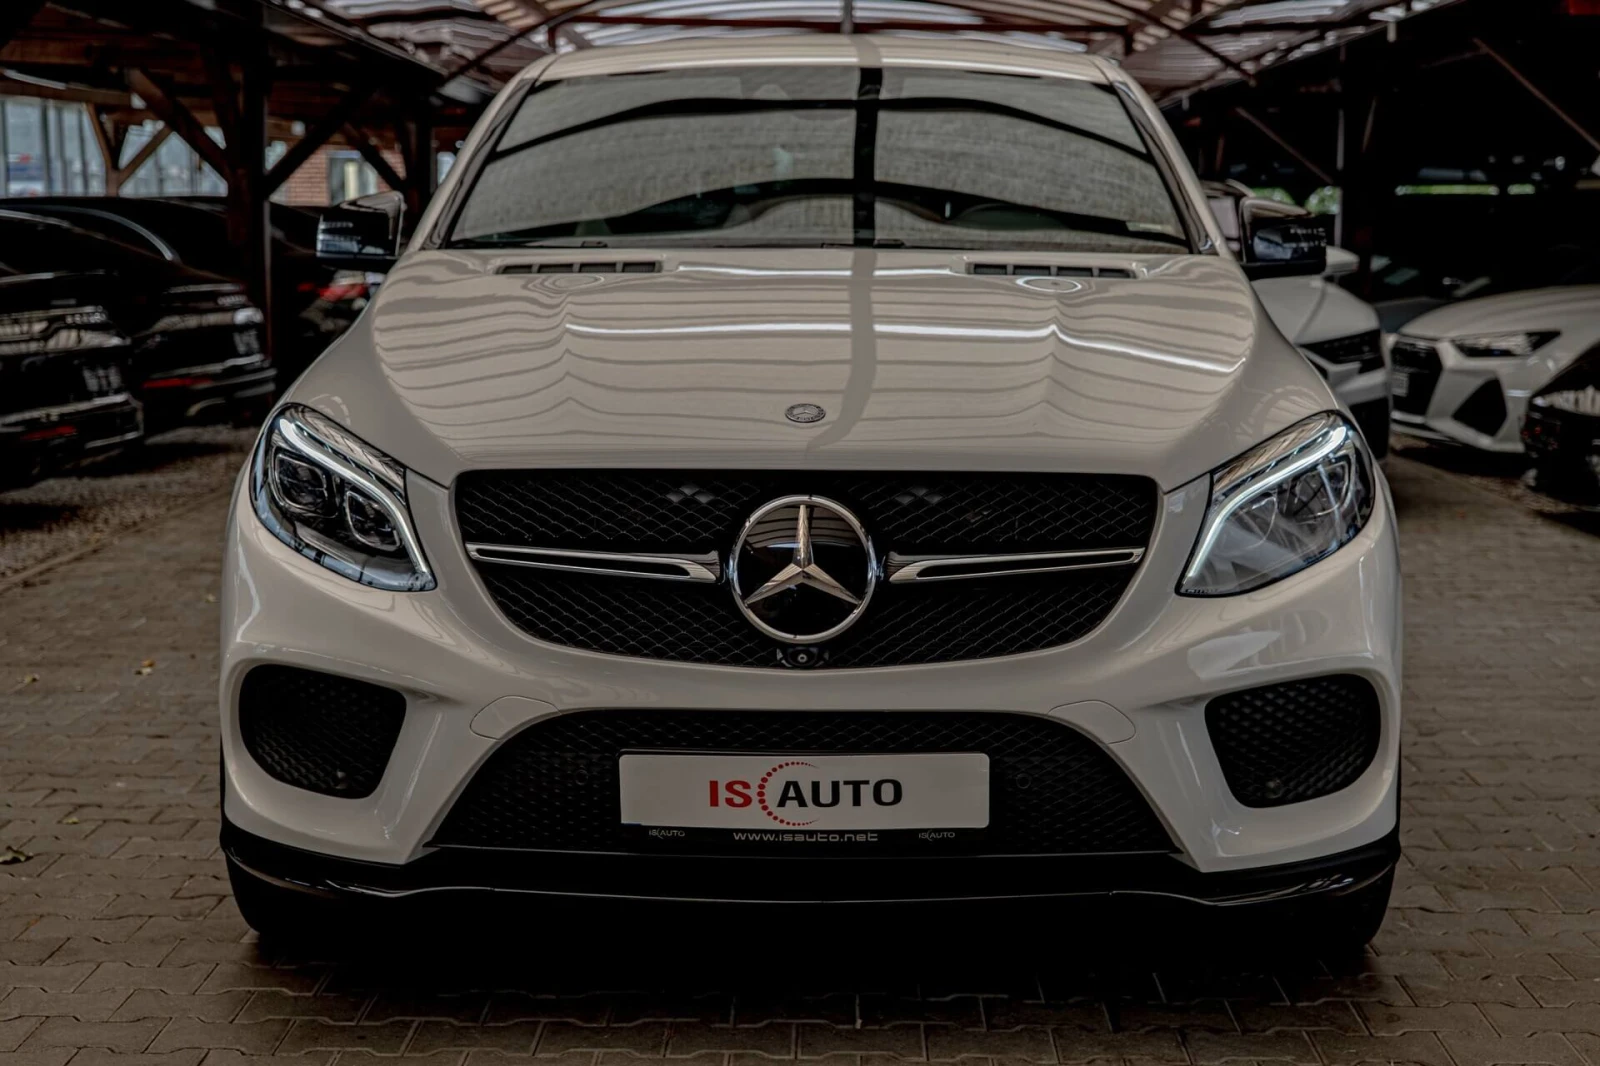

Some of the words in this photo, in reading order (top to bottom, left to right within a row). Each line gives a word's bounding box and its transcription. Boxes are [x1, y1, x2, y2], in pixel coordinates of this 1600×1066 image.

[709, 780, 753, 808] IS
[776, 779, 903, 808] AUTO
[659, 829, 686, 837] AUTO
[732, 832, 879, 842] www.isauto.net
[929, 831, 956, 839] AUTO
